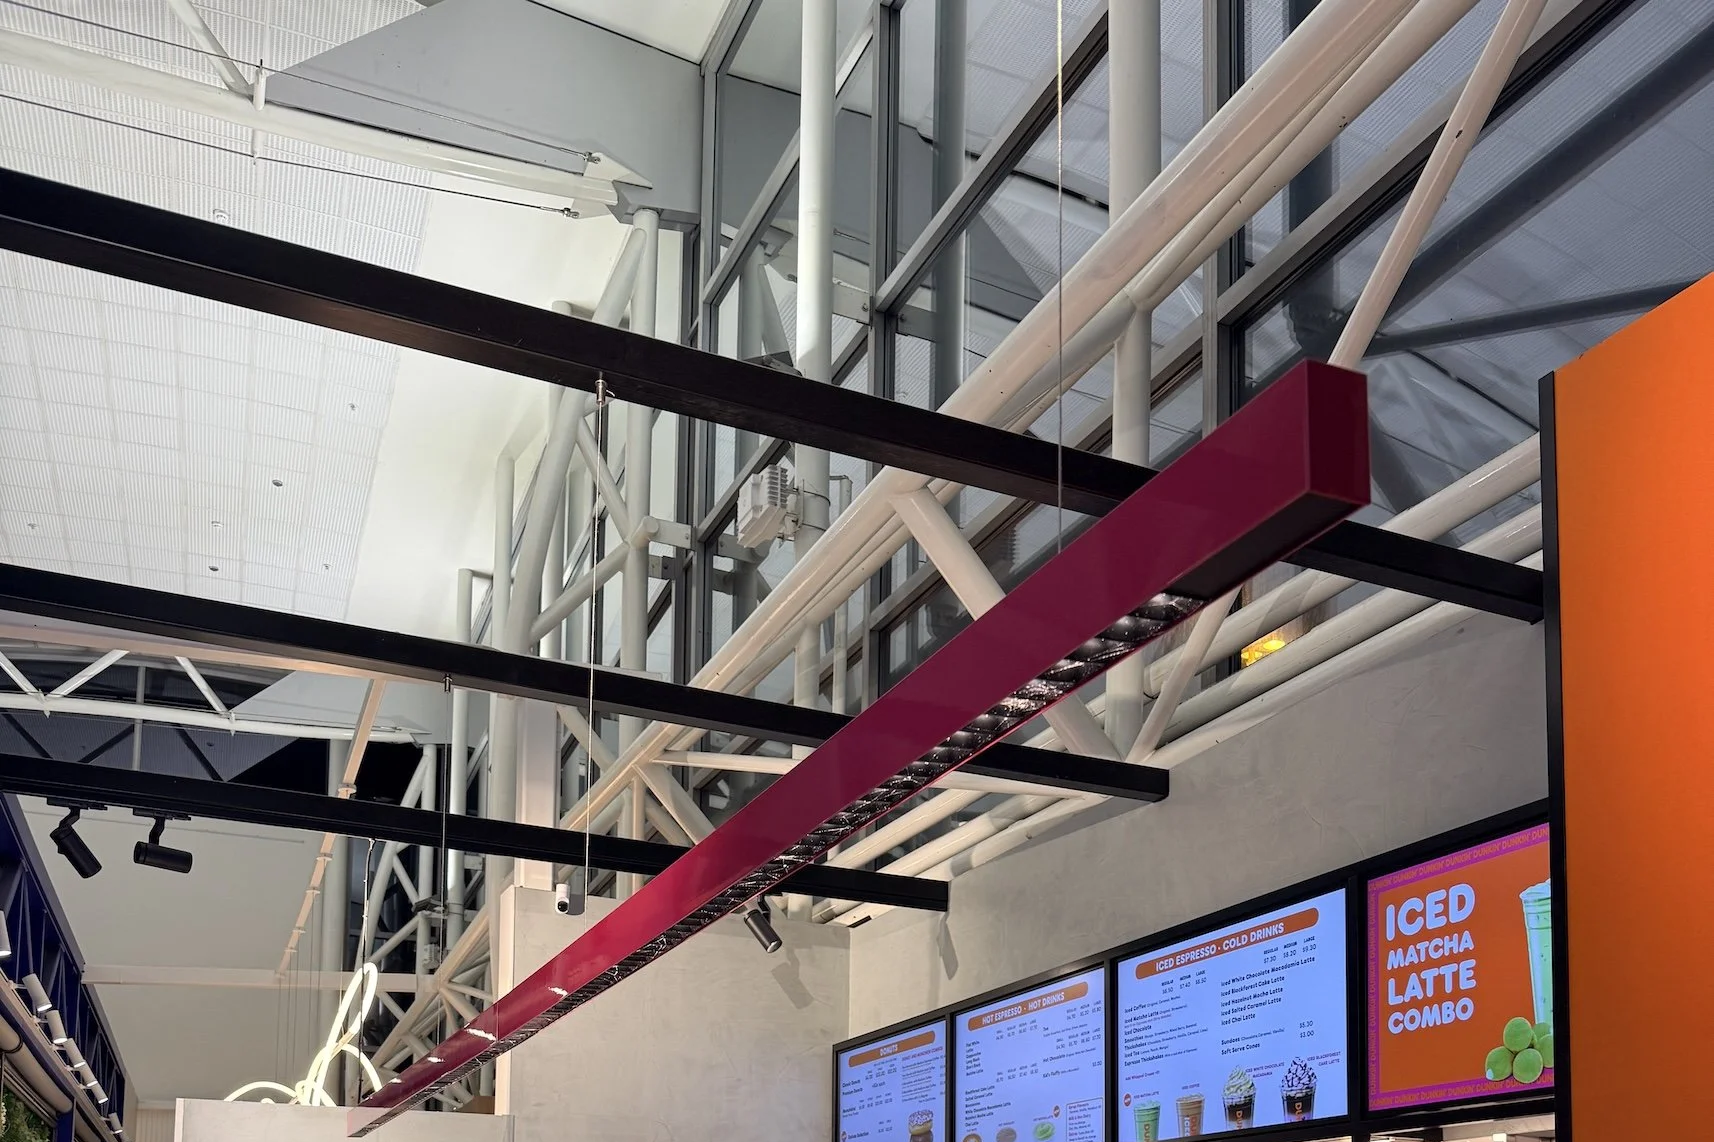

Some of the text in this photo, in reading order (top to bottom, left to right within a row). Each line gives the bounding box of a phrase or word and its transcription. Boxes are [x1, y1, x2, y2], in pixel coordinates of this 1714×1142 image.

[1385, 883, 1476, 942] ICED
[1155, 922, 1285, 972] ICED ESPRESSO COLD DRINKS
[1387, 930, 1475, 971] MATCHA
[1232, 976, 1245, 984] White
[1246, 969, 1270, 980] Chocolate
[1270, 960, 1300, 973] Macadamia
[1300, 956, 1316, 965] Latte
[1388, 959, 1477, 1006] LATTE
[1232, 983, 1258, 995] Blackforest
[1270, 976, 1285, 984] Latte
[1232, 995, 1252, 1005] Hazelnut
[1252, 990, 1269, 999] Mocha
[1269, 987, 1284, 995] Latte
[982, 992, 1065, 1025] HOT ESPRESSO HOT DRINKS
[1232, 1005, 1246, 1014] Salted
[1246, 1000, 1267, 1010] Caramel
[1267, 997, 1282, 1005] Latte
[1232, 1016, 1242, 1024] Chai
[1242, 1012, 1256, 1021] Latte
[1388, 997, 1475, 1035] COMBO
[1221, 1048, 1232, 1056] Soft
[1232, 1045, 1245, 1053] Serve
[1246, 1042, 1260, 1050] Cones
